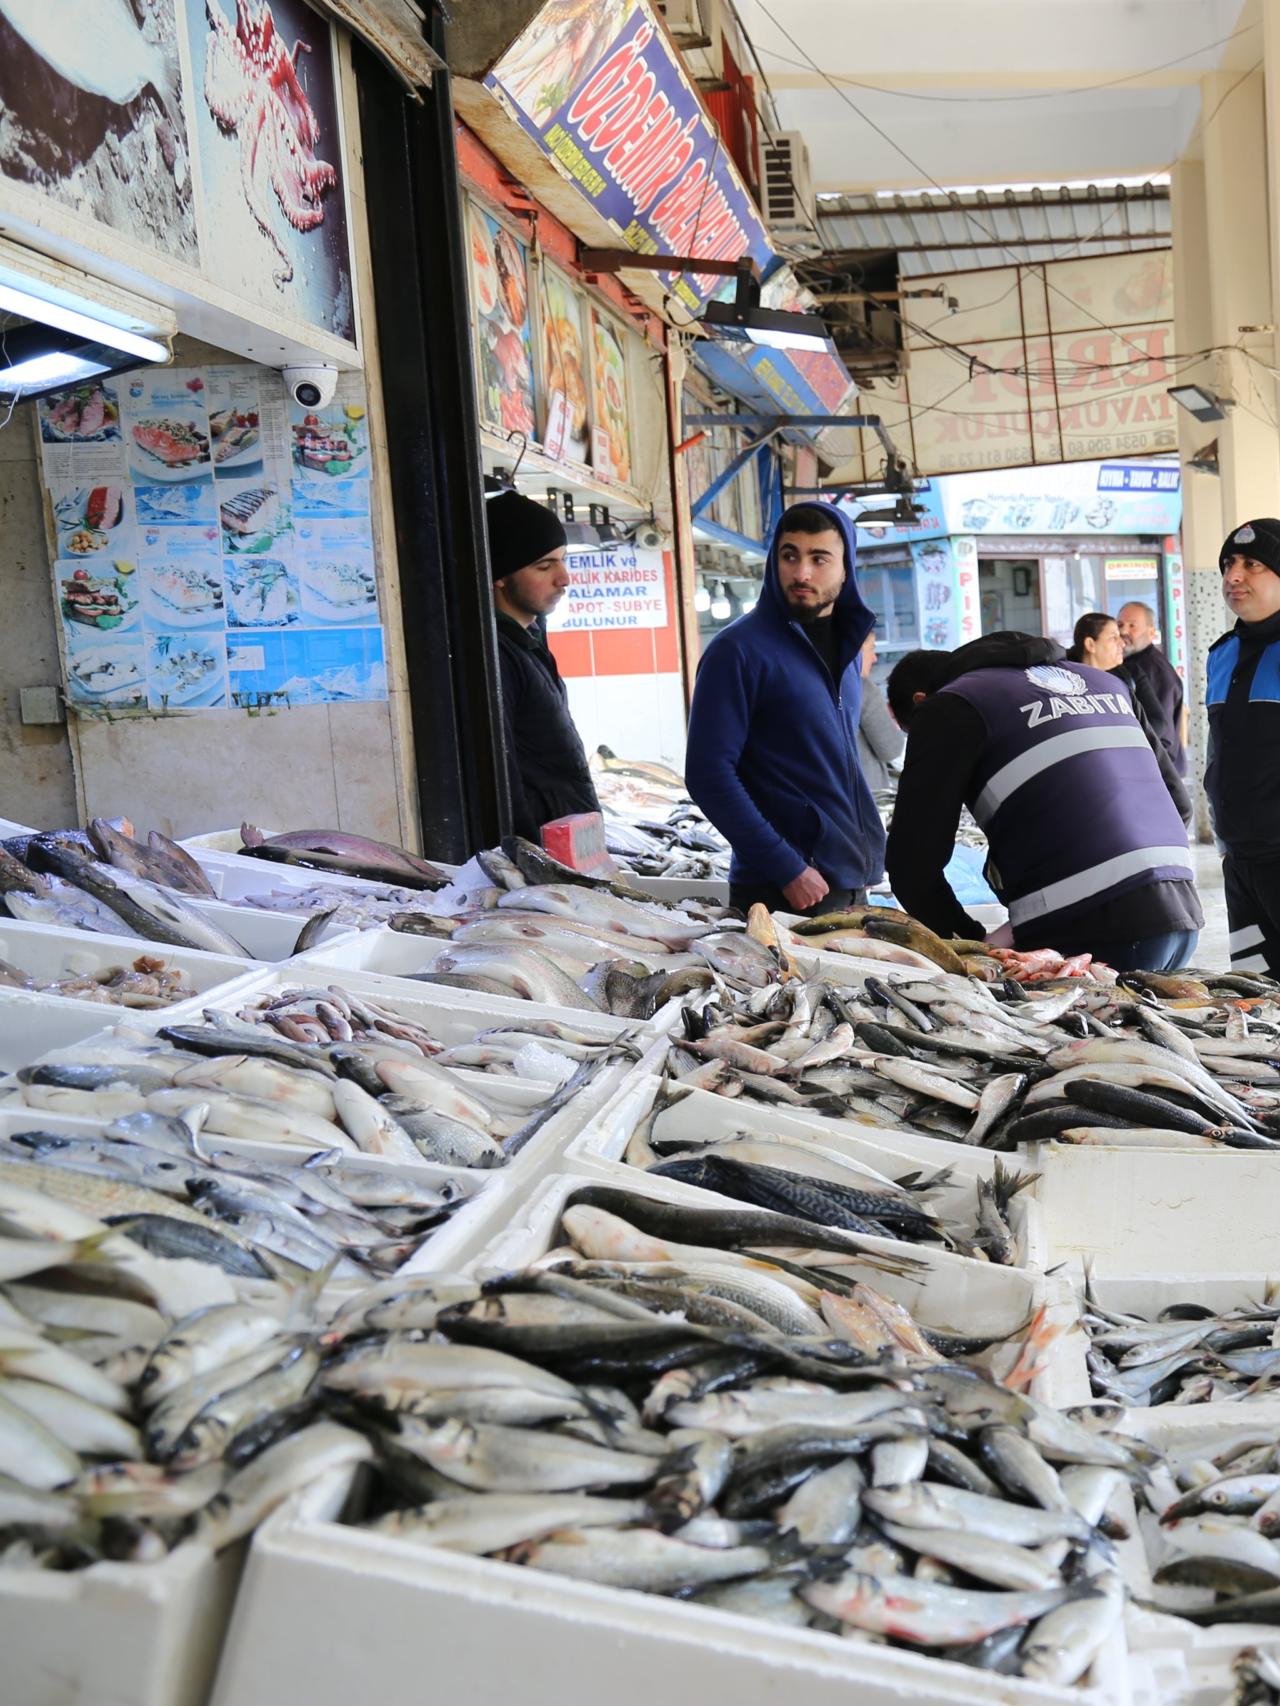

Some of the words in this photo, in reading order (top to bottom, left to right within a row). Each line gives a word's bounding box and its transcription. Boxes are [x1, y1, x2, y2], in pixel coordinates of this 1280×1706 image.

[567, 20, 702, 216] ÖZDEMİR
[620, 556, 638, 568] ve
[568, 569, 600, 585] KLİK
[604, 568, 658, 584] KARİDES
[567, 586, 648, 599] ALAMAR
[1019, 693, 1137, 729] ZABITA
